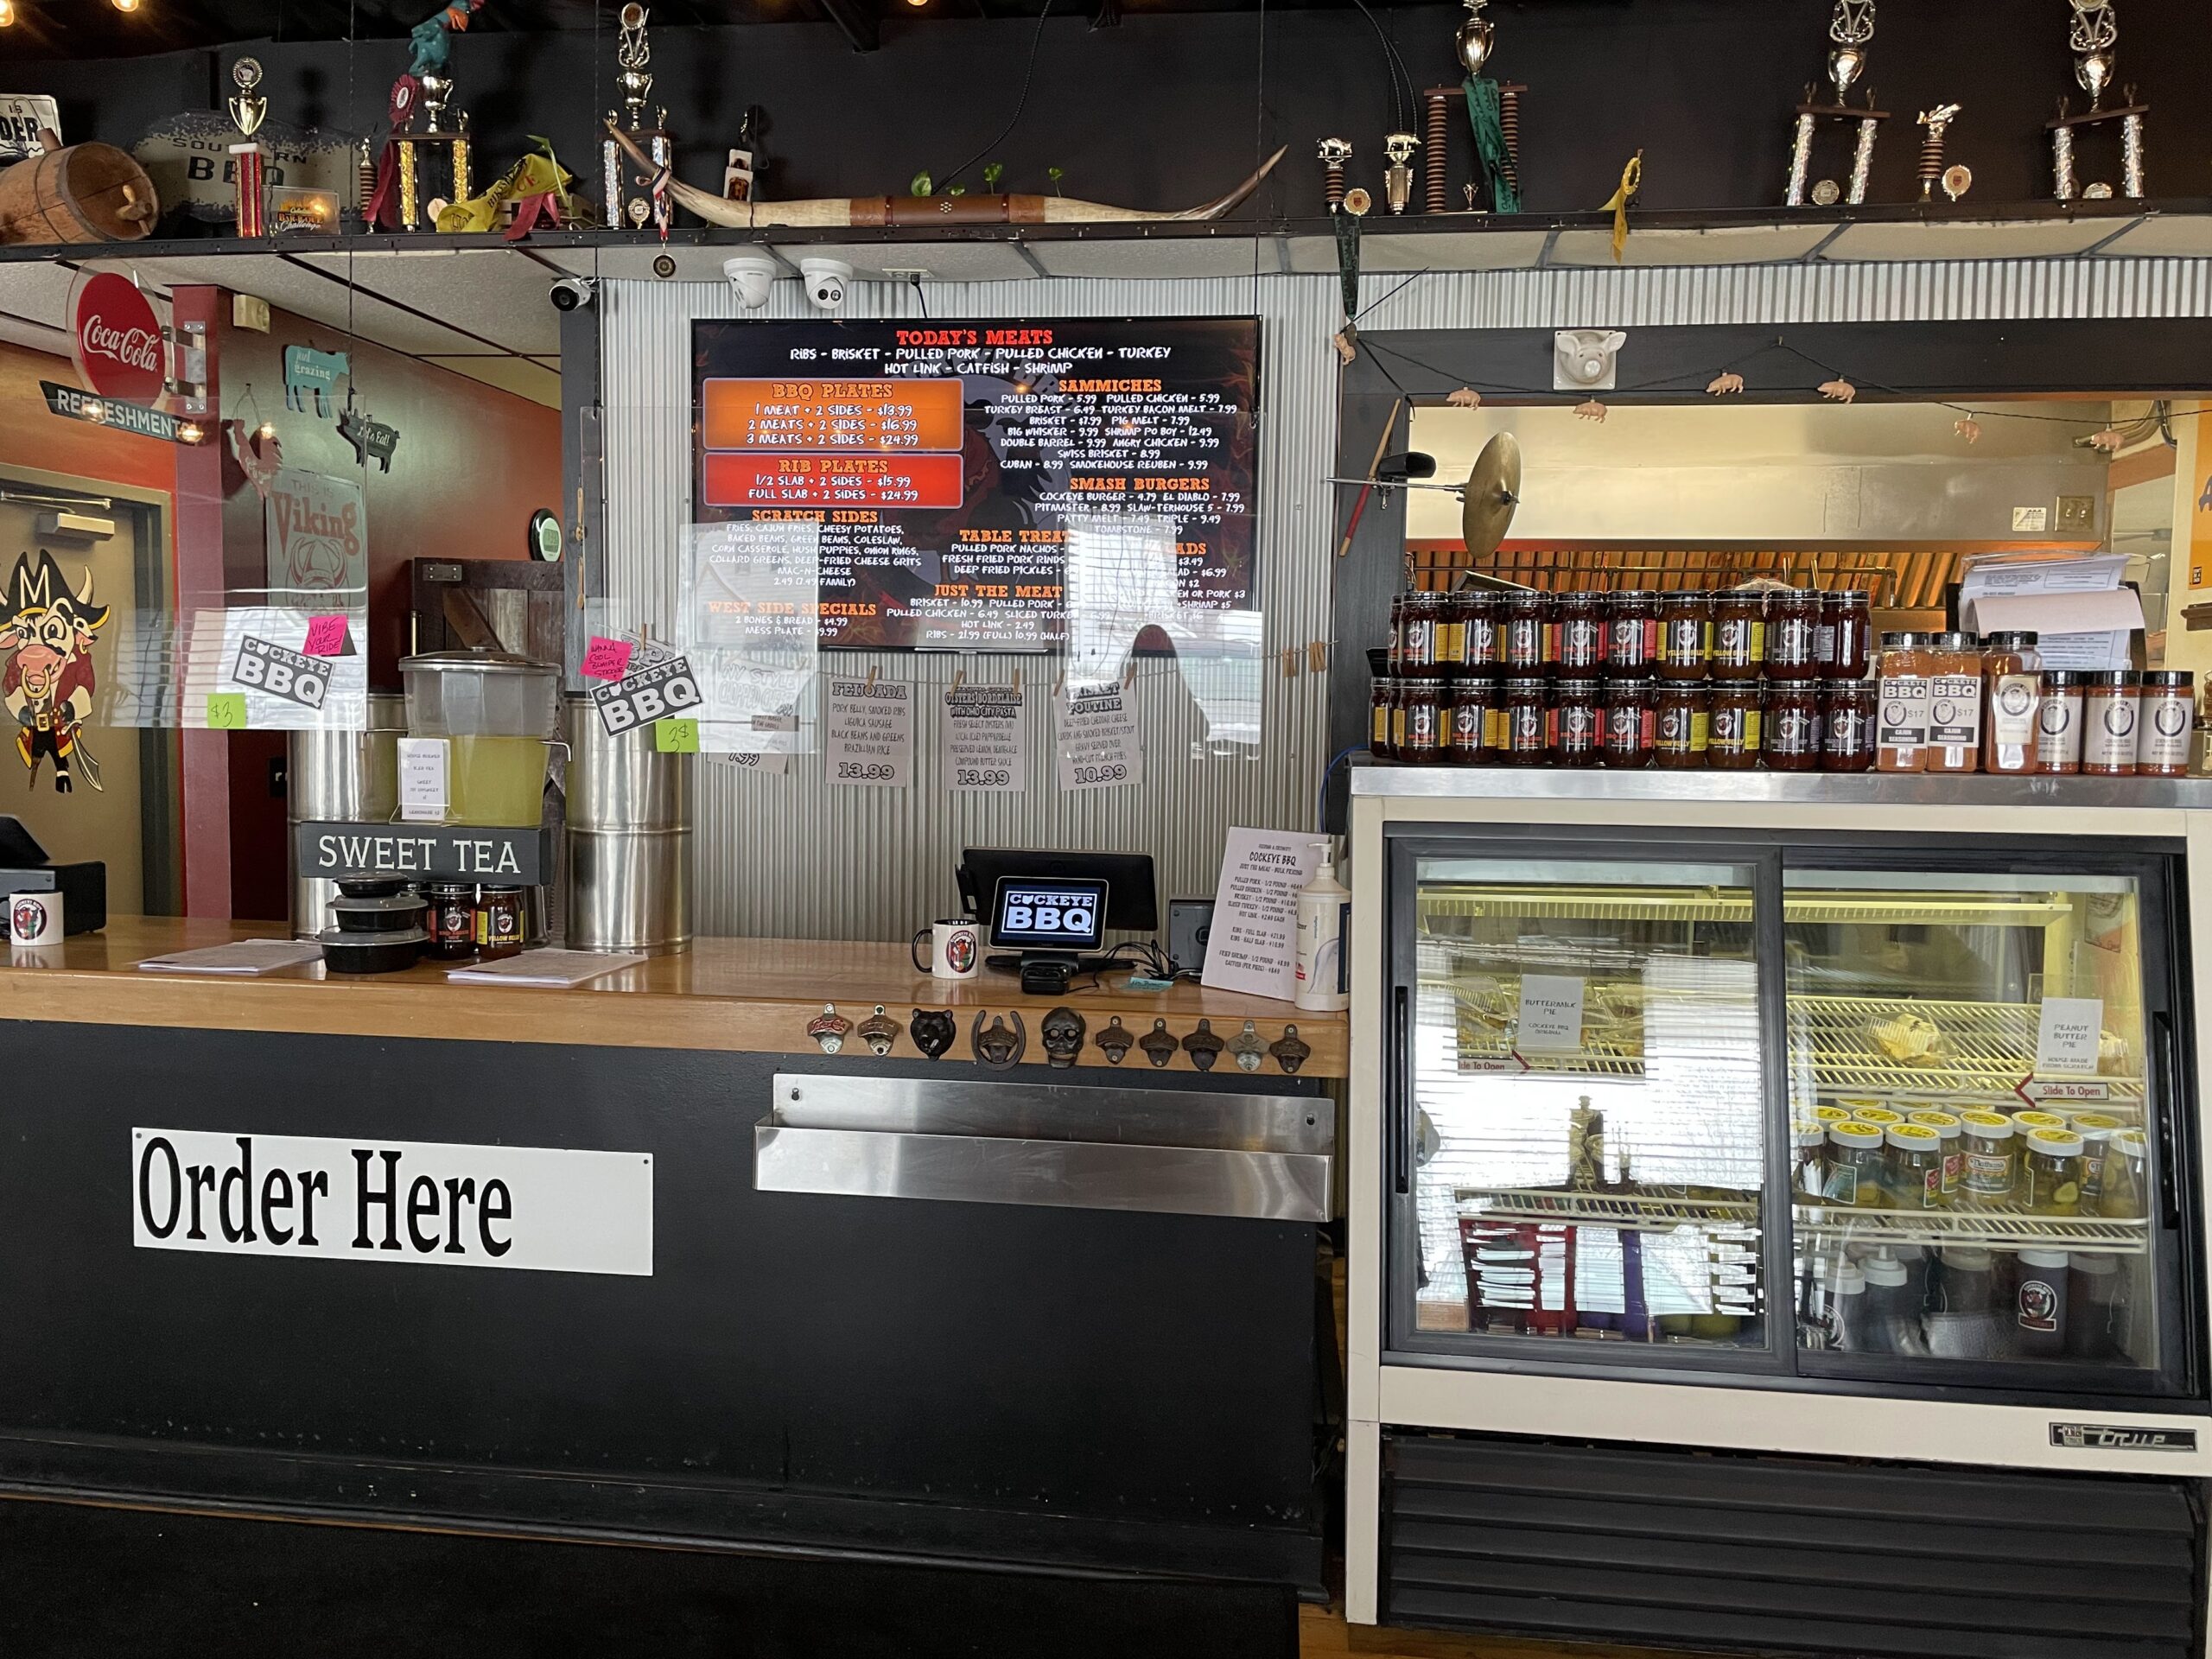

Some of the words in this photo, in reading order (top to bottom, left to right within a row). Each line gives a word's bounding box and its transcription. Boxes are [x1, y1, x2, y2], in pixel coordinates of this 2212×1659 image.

[173, 138, 306, 164] SOURN
[84, 315, 160, 372] Coca-Cola
[896, 330, 976, 345] TODAY'S
[986, 330, 1052, 344] MEATS
[791, 348, 817, 359] RIBS
[832, 348, 880, 359] BRISKET
[896, 348, 943, 359] PULLED
[948, 348, 978, 359] PORK
[995, 348, 1044, 359] PULLED
[1048, 348, 1103, 359] CHICKEN
[1119, 348, 1171, 359] TURKEY
[295, 363, 331, 380] grazing
[885, 363, 908, 374] HOT
[913, 363, 940, 374] LINK
[957, 363, 1009, 374] CATFISH
[1025, 363, 1072, 374] SHRIMP
[1059, 380, 1161, 391] SAMMICHES
[772, 384, 814, 400] BBQ
[821, 384, 893, 398] PLATES
[755, 404, 760, 416] 1
[764, 404, 799, 416] MEAT
[816, 404, 823, 416] 2
[827, 404, 863, 416] SIDES
[878, 404, 912, 416] $13.99
[984, 405, 1023, 414] TURKEY
[1025, 405, 1061, 414] BREAST
[1073, 405, 1095, 414] 6.49
[1102, 405, 1141, 414] TURKEY
[1143, 405, 1176, 414] BACON
[1179, 405, 1206, 414] MELT
[1217, 405, 1237, 414] 7.99
[747, 419, 756, 430] 2
[760, 419, 804, 430] MEATS
[819, 419, 827, 430] 2
[830, 419, 866, 430] SIDES
[880, 419, 918, 430] $16.99
[1029, 416, 1067, 425] BRISKET
[1078, 416, 1102, 425] $7.99
[1111, 416, 1129, 425] PIG
[1132, 416, 1160, 425] MELT
[1171, 416, 1190, 425] 7.99
[1189, 426, 1212, 435] 12.49
[747, 434, 754, 444] 3
[759, 434, 803, 444] MEATS
[817, 434, 826, 444] 2
[830, 434, 865, 444] SIDES
[880, 434, 918, 444] $24.99
[1058, 449, 1086, 458] SWISS
[1088, 449, 1128, 458] BRISKET
[1140, 449, 1160, 458] 8.99
[779, 459, 811, 473] RIB
[821, 459, 888, 473] PLATES
[1000, 461, 1032, 469] CUBAN
[1043, 461, 1063, 469] 8.99
[1069, 461, 1135, 469] SMOKEHOUSE
[1137, 461, 1176, 469] REUBEN
[1187, 461, 1208, 469] 9.99
[756, 475, 773, 486] 1/2
[778, 475, 804, 486] SLAB
[821, 475, 827, 486] 2
[830, 475, 863, 486] SIDES
[878, 475, 912, 486] $15.99
[1070, 478, 1126, 490] SMASH
[1134, 478, 1210, 490] BURGERS
[749, 489, 777, 499] FULL
[781, 489, 808, 499] SLAB
[823, 489, 830, 499] 2
[834, 489, 866, 499] SIDES
[881, 489, 918, 499] $24.99
[1039, 493, 1084, 501] COCKEYE
[1086, 493, 1126, 501] BURGER
[1137, 493, 1156, 501] 4.79
[1163, 493, 1175, 501] EL
[1178, 493, 1209, 501] DIABLO
[1221, 493, 1240, 501] 7.99
[752, 510, 825, 523] SCRATCH
[832, 510, 877, 523] SIDES
[271, 491, 359, 560] Viking
[311, 619, 338, 636] VIBE
[589, 654, 610, 664] COOL
[589, 658, 624, 670] BUMPER
[236, 652, 324, 708] BBQ
[1885, 687, 1926, 699] BBQ
[1934, 685, 1977, 697] BBQ
[601, 677, 700, 733] BBQ
[1066, 697, 1122, 715] POUTINE
[211, 701, 233, 727] $3
[995, 707, 1017, 718] PASTA
[669, 722, 689, 753] 3$
[831, 729, 849, 739] BLACK
[851, 730, 868, 741] BEANS
[838, 762, 894, 780] 13.99
[957, 769, 1010, 785] 13.99
[1074, 765, 1127, 784] 10.99
[318, 835, 436, 871] SWEET
[453, 839, 521, 874] TEA
[1249, 852, 1281, 863] COCKEYE
[1282, 855, 1296, 866] BBQ
[1006, 906, 1091, 933] BBQ
[1525, 999, 1576, 1008] BUTTERMILK
[2043, 1085, 2063, 1095] Slide
[2066, 1086, 2075, 1095] To
[2078, 1086, 2101, 1097] Open
[139, 1137, 328, 1246] Order
[352, 1149, 512, 1257] Here
